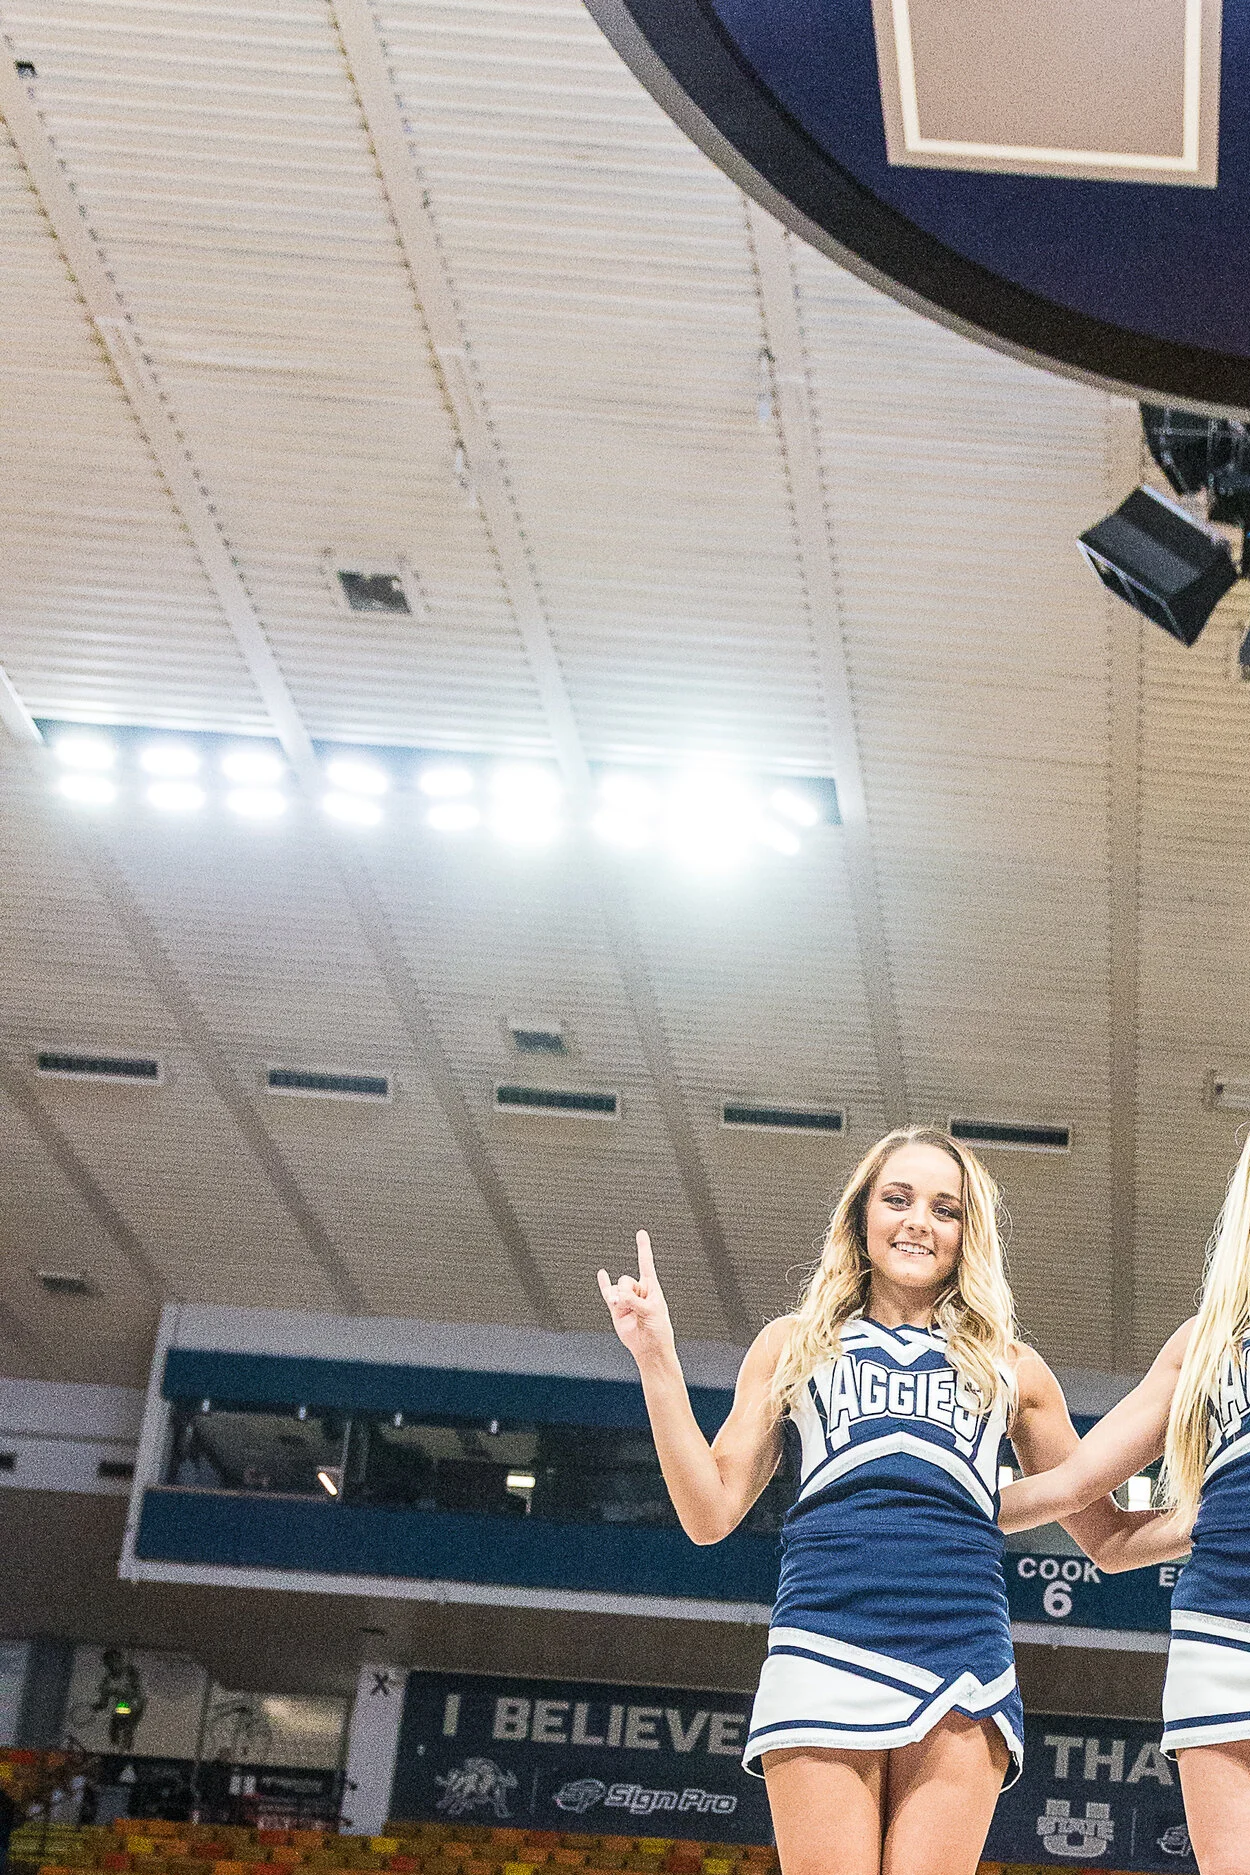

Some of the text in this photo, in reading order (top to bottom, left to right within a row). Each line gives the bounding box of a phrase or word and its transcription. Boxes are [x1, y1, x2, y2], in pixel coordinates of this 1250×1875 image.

[829, 1354, 980, 1442] AGGIES
[1017, 1557, 1101, 1584] COOK
[1043, 1581, 1073, 1618] 6
[370, 1672, 390, 1697] X
[443, 1694, 746, 1757] I BELIEVE
[1044, 1736, 1175, 1787] THA
[604, 1783, 678, 1815] Sign
[678, 1788, 738, 1814] Pro
